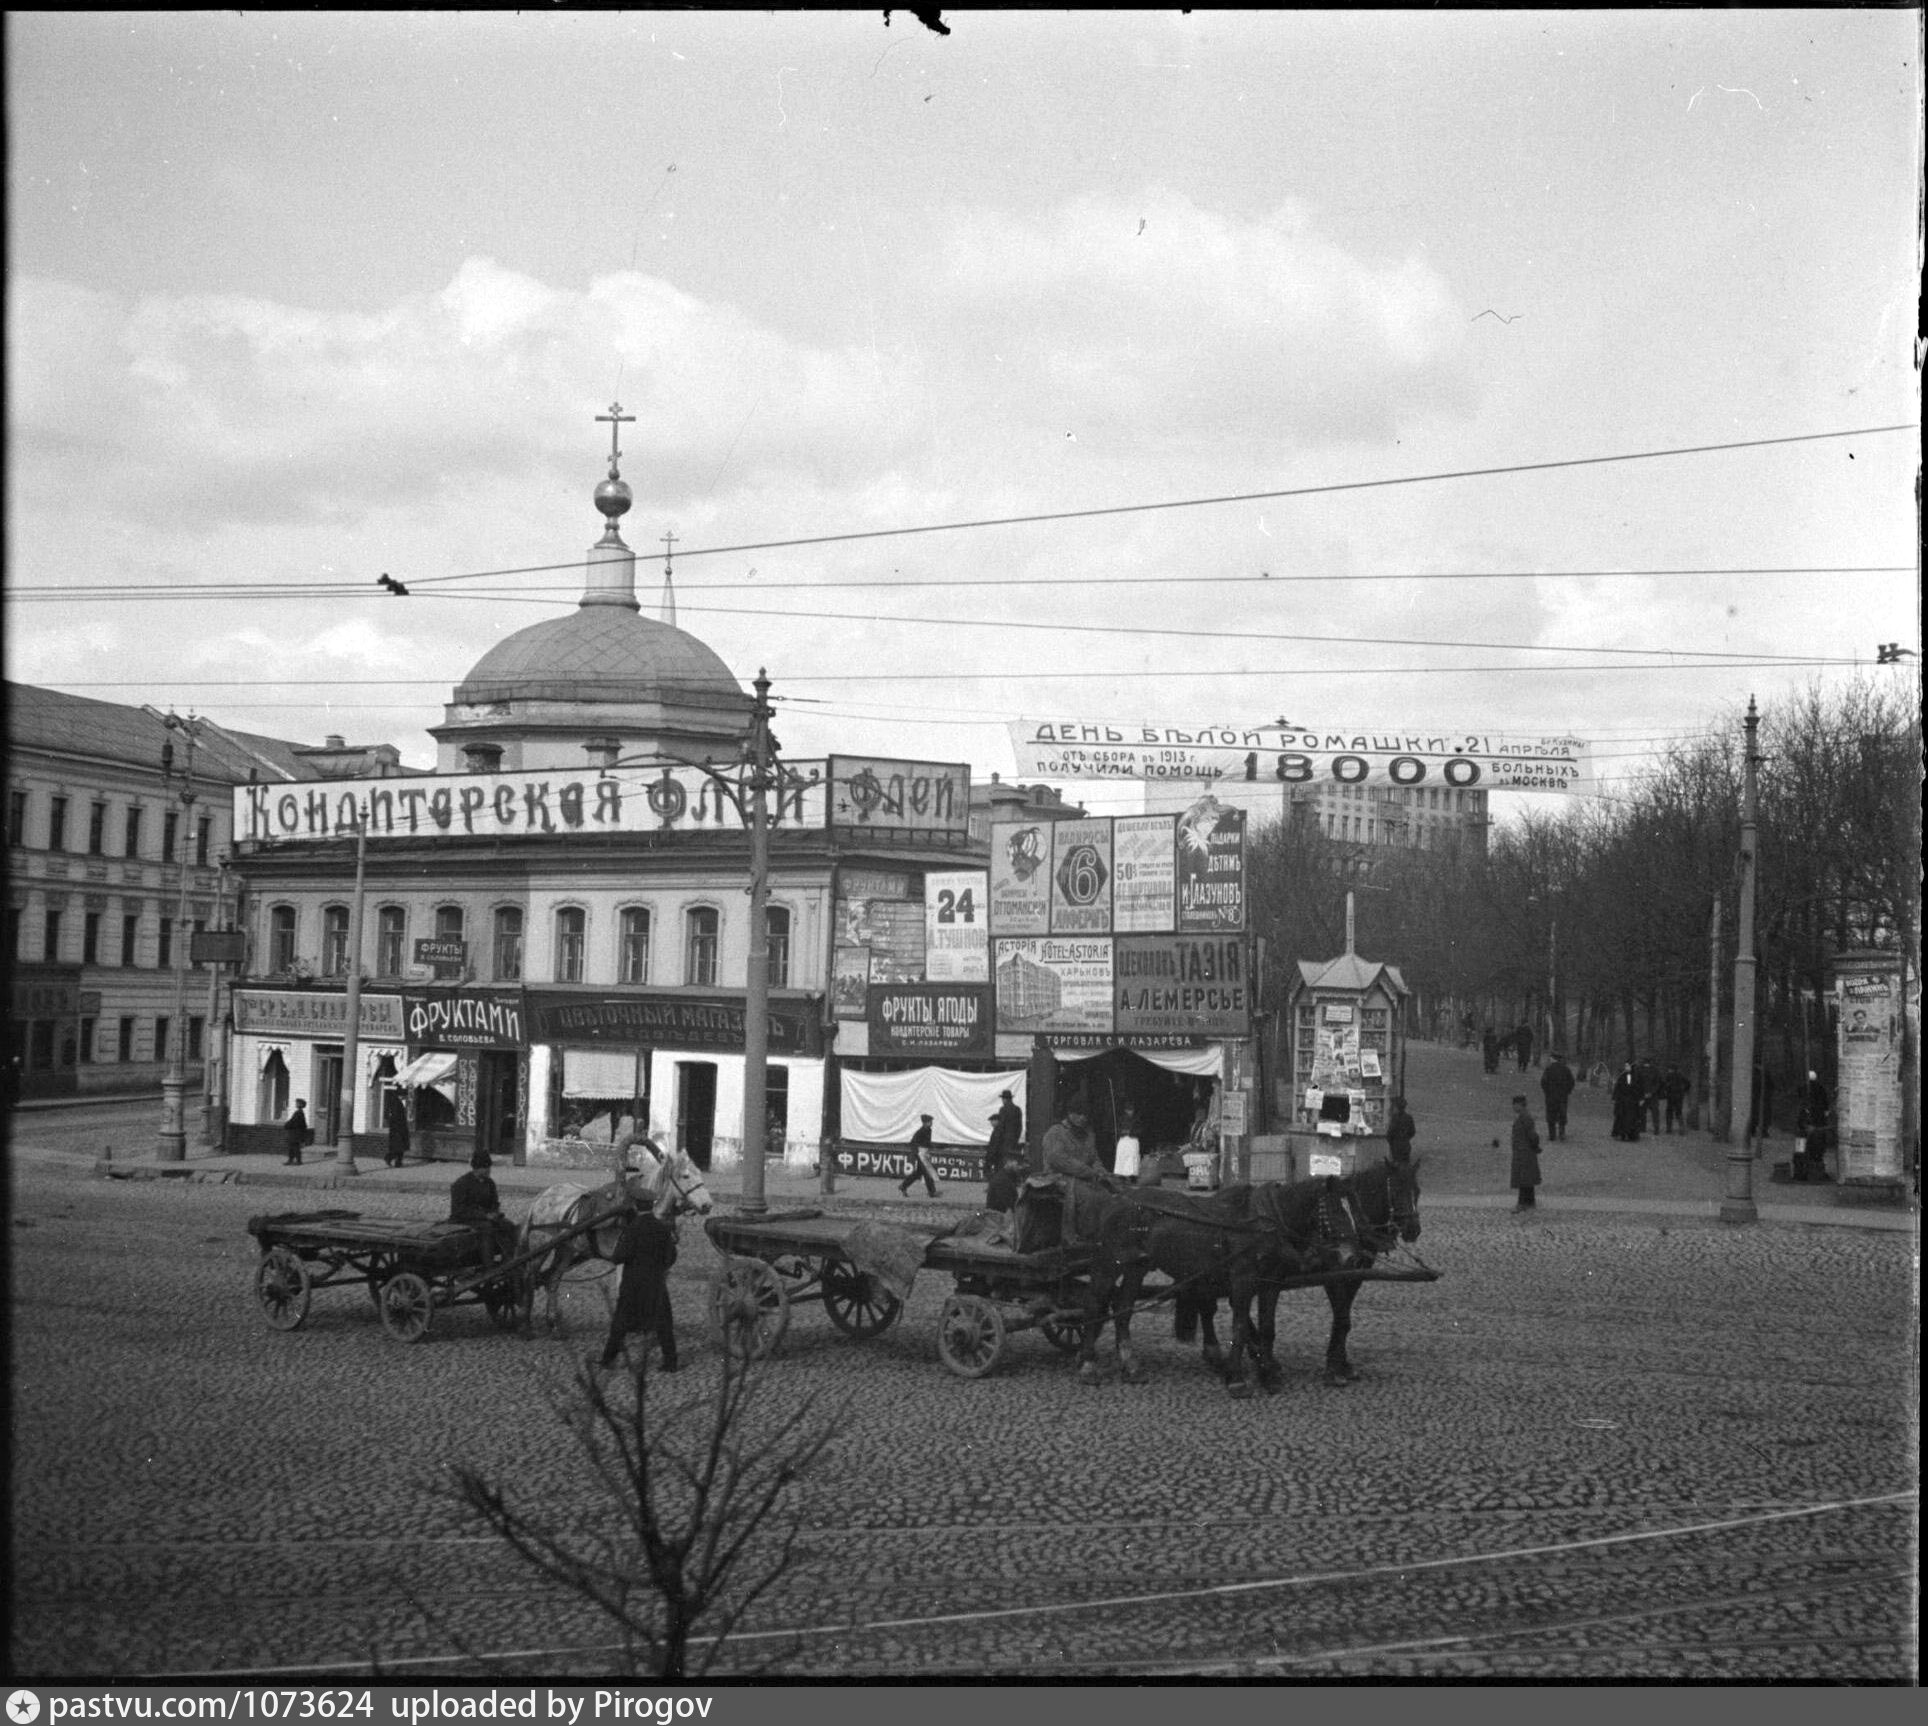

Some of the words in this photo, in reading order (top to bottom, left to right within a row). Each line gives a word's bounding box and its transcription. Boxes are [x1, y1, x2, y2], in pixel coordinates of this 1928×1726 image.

[1036, 724, 1123, 742] ДЕНЬ
[1280, 733, 1446, 752] РОМАШКИ
[1465, 736, 1489, 753] 21
[1062, 751, 1086, 761] ОТЪ
[1093, 751, 1135, 762] СБОРА
[1160, 750, 1186, 763] 1913
[1037, 761, 1133, 775] ПОЛУЧИЛИ
[1144, 763, 1223, 778] ПОМОЩЬ
[1244, 751, 1481, 787] 18000
[1491, 762, 1579, 778] БОЛЬНЫХЪ
[1069, 847, 1098, 903] 6
[937, 888, 975, 923] 24
[420, 942, 463, 955] ФРУКТЫ
[998, 941, 1037, 956] АСТОРІЯ
[1060, 967, 1111, 977] ХАРЬКОВЪ
[1138, 987, 1244, 1011] ЛЕМЕРСЬЕ
[882, 996, 932, 1022] ФРУКТЫ
[937, 996, 977, 1025] ЯГОДЫ
[410, 999, 520, 1041] ФРУКТАМИ
[681, 1007, 785, 1038] МАГАЗЪ
[942, 1026, 969, 1038] ТОВАРЫ
[1046, 1035, 1101, 1046] ТОРГОВЛЯ
[1129, 1036, 1192, 1047] ЛАЗАРЕВА
[931, 1155, 966, 1167] ВАСЪ
[937, 1166, 973, 1180] ОДЫ
